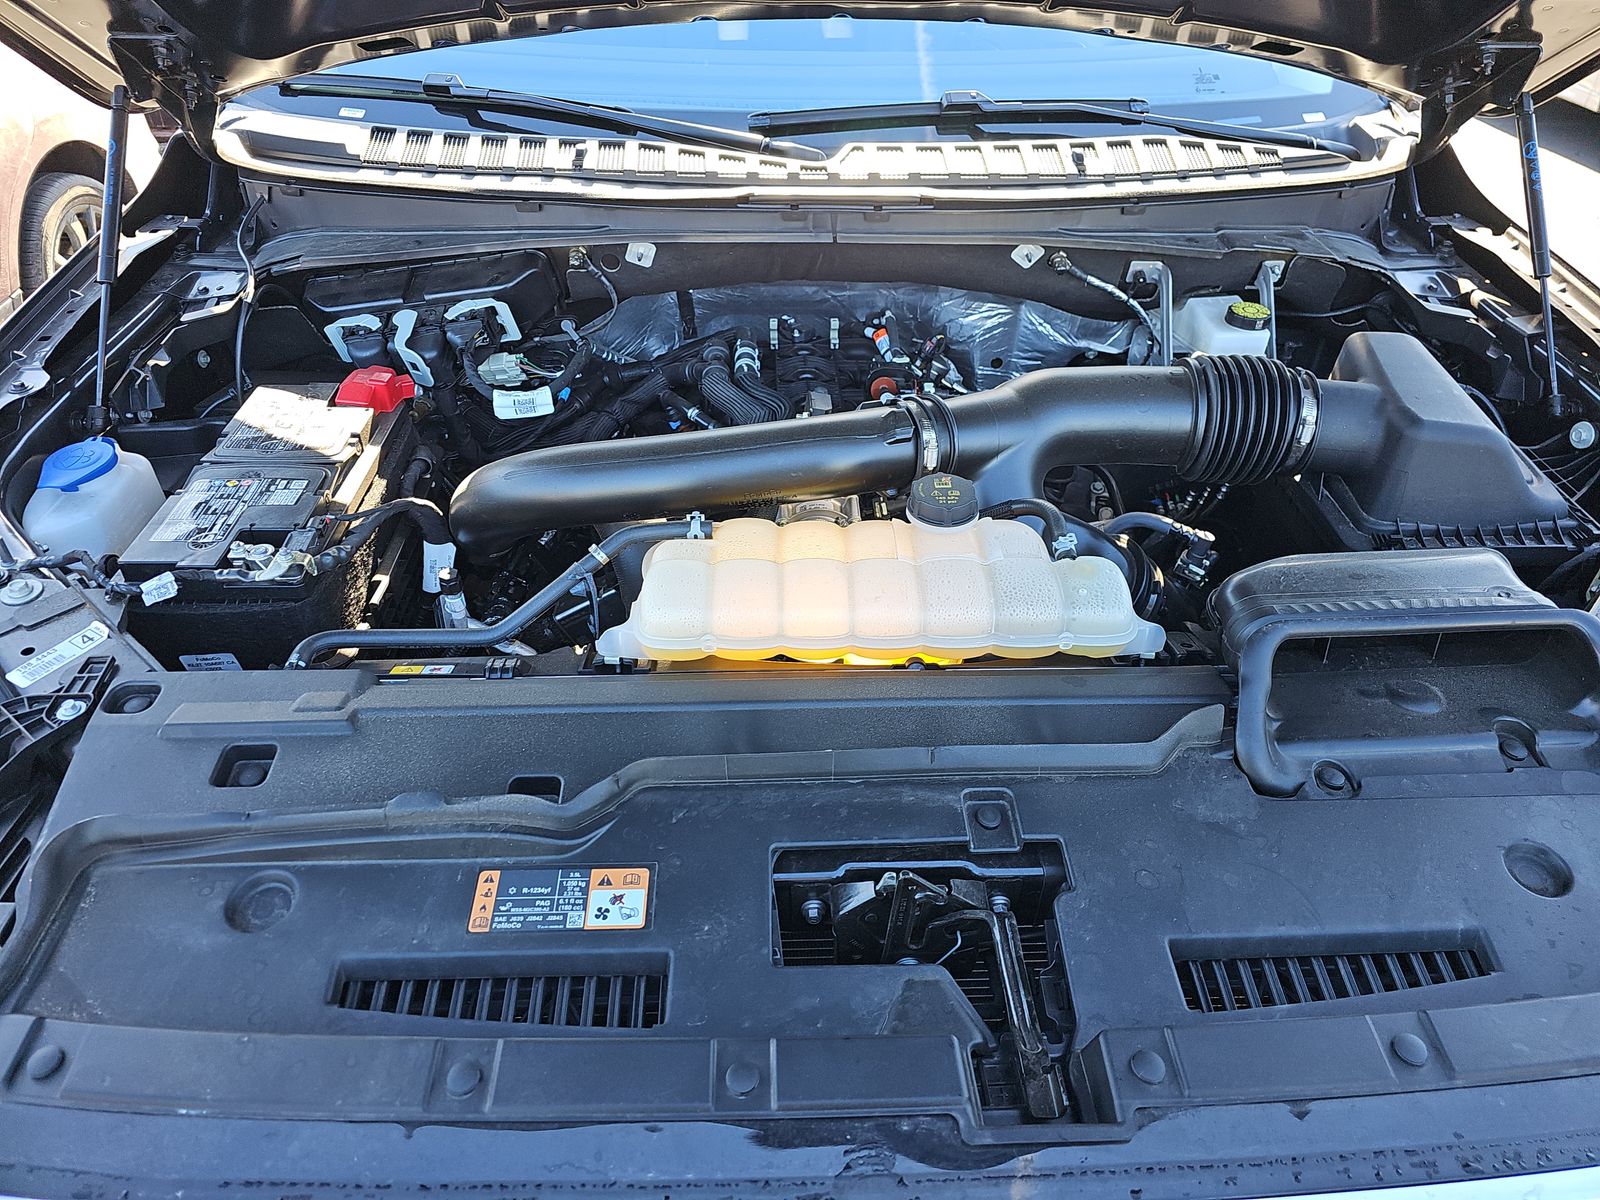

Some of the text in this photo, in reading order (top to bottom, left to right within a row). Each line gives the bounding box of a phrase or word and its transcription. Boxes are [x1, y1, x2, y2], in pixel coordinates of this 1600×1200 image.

[81, 634, 95, 644] 4
[578, 880, 586, 888] kg
[522, 886, 552, 894] R-1234yf
